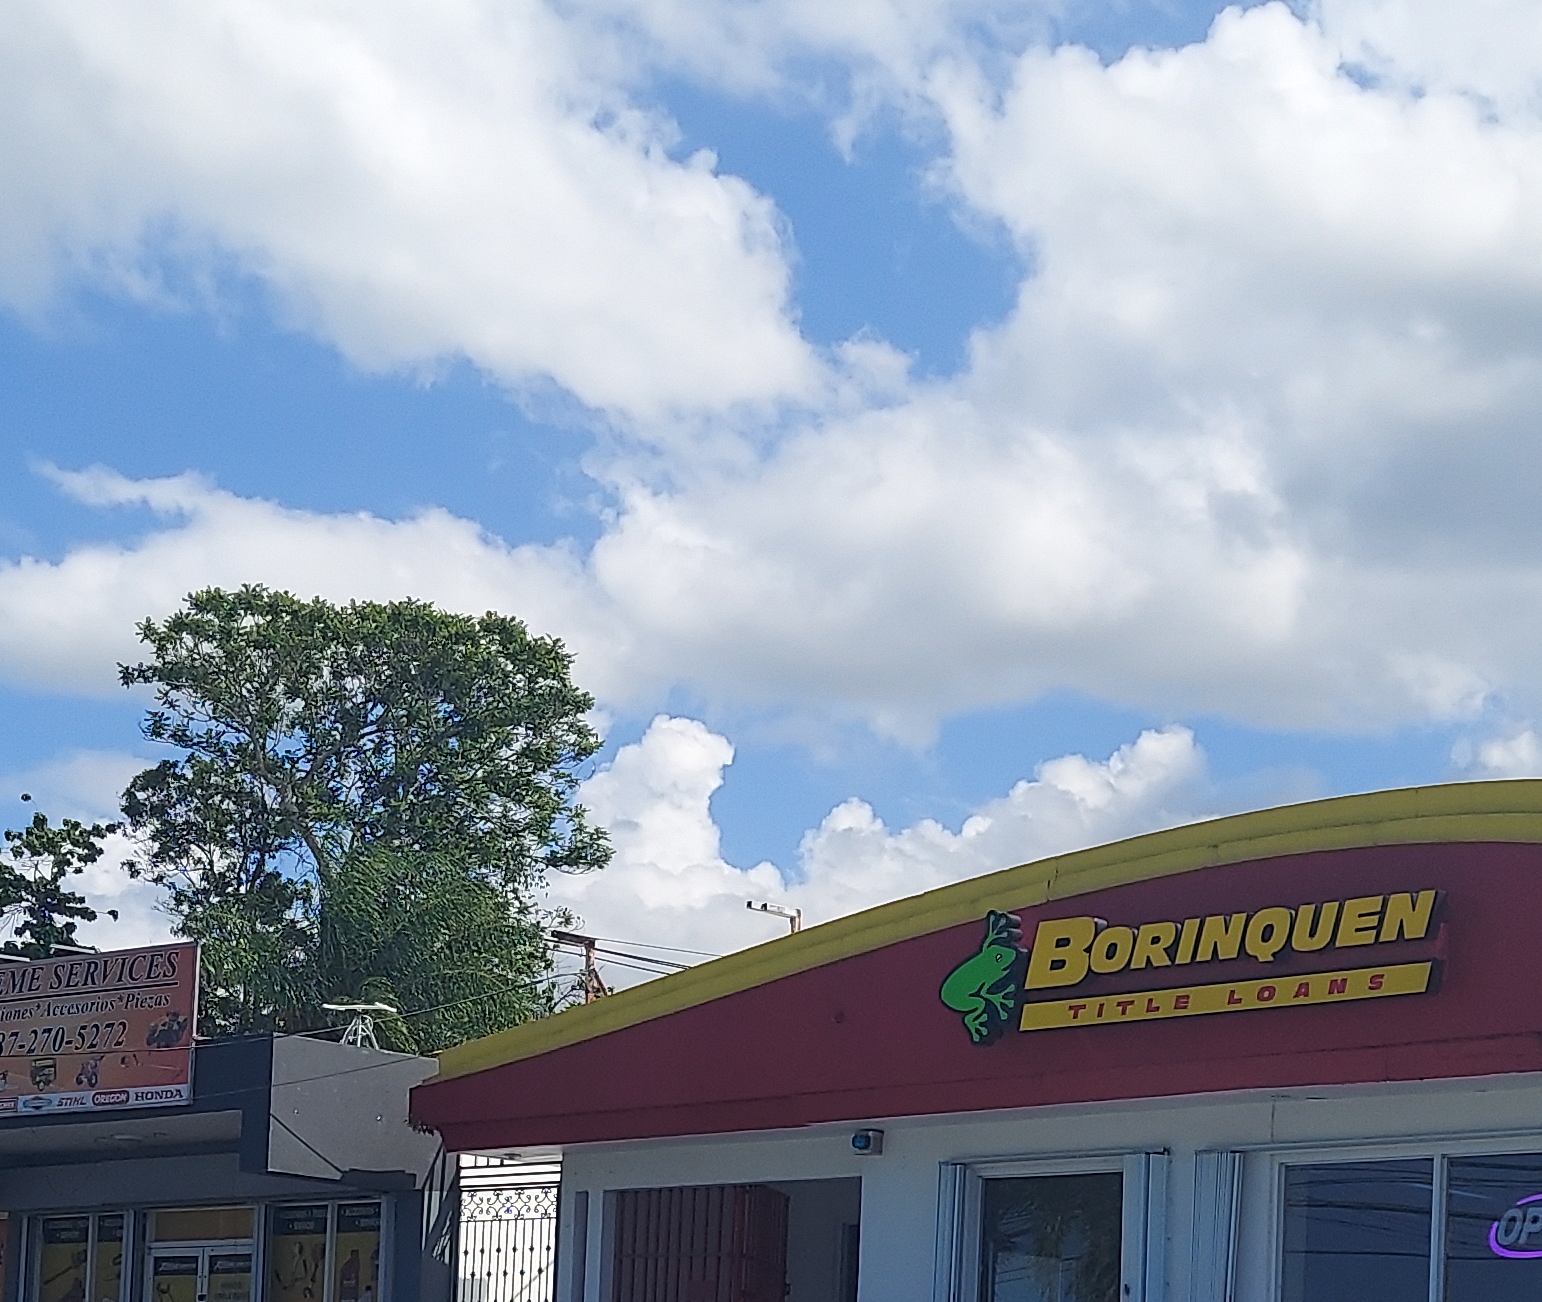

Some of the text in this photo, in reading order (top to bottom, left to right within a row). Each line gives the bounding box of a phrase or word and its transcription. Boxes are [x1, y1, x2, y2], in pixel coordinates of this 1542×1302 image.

[1025, 890, 1436, 989] BORINQUEN
[49, 951, 180, 990] SERVICES
[1068, 974, 1385, 1020] TITLE LOANS
[135, 1089, 183, 1102] HONDA
